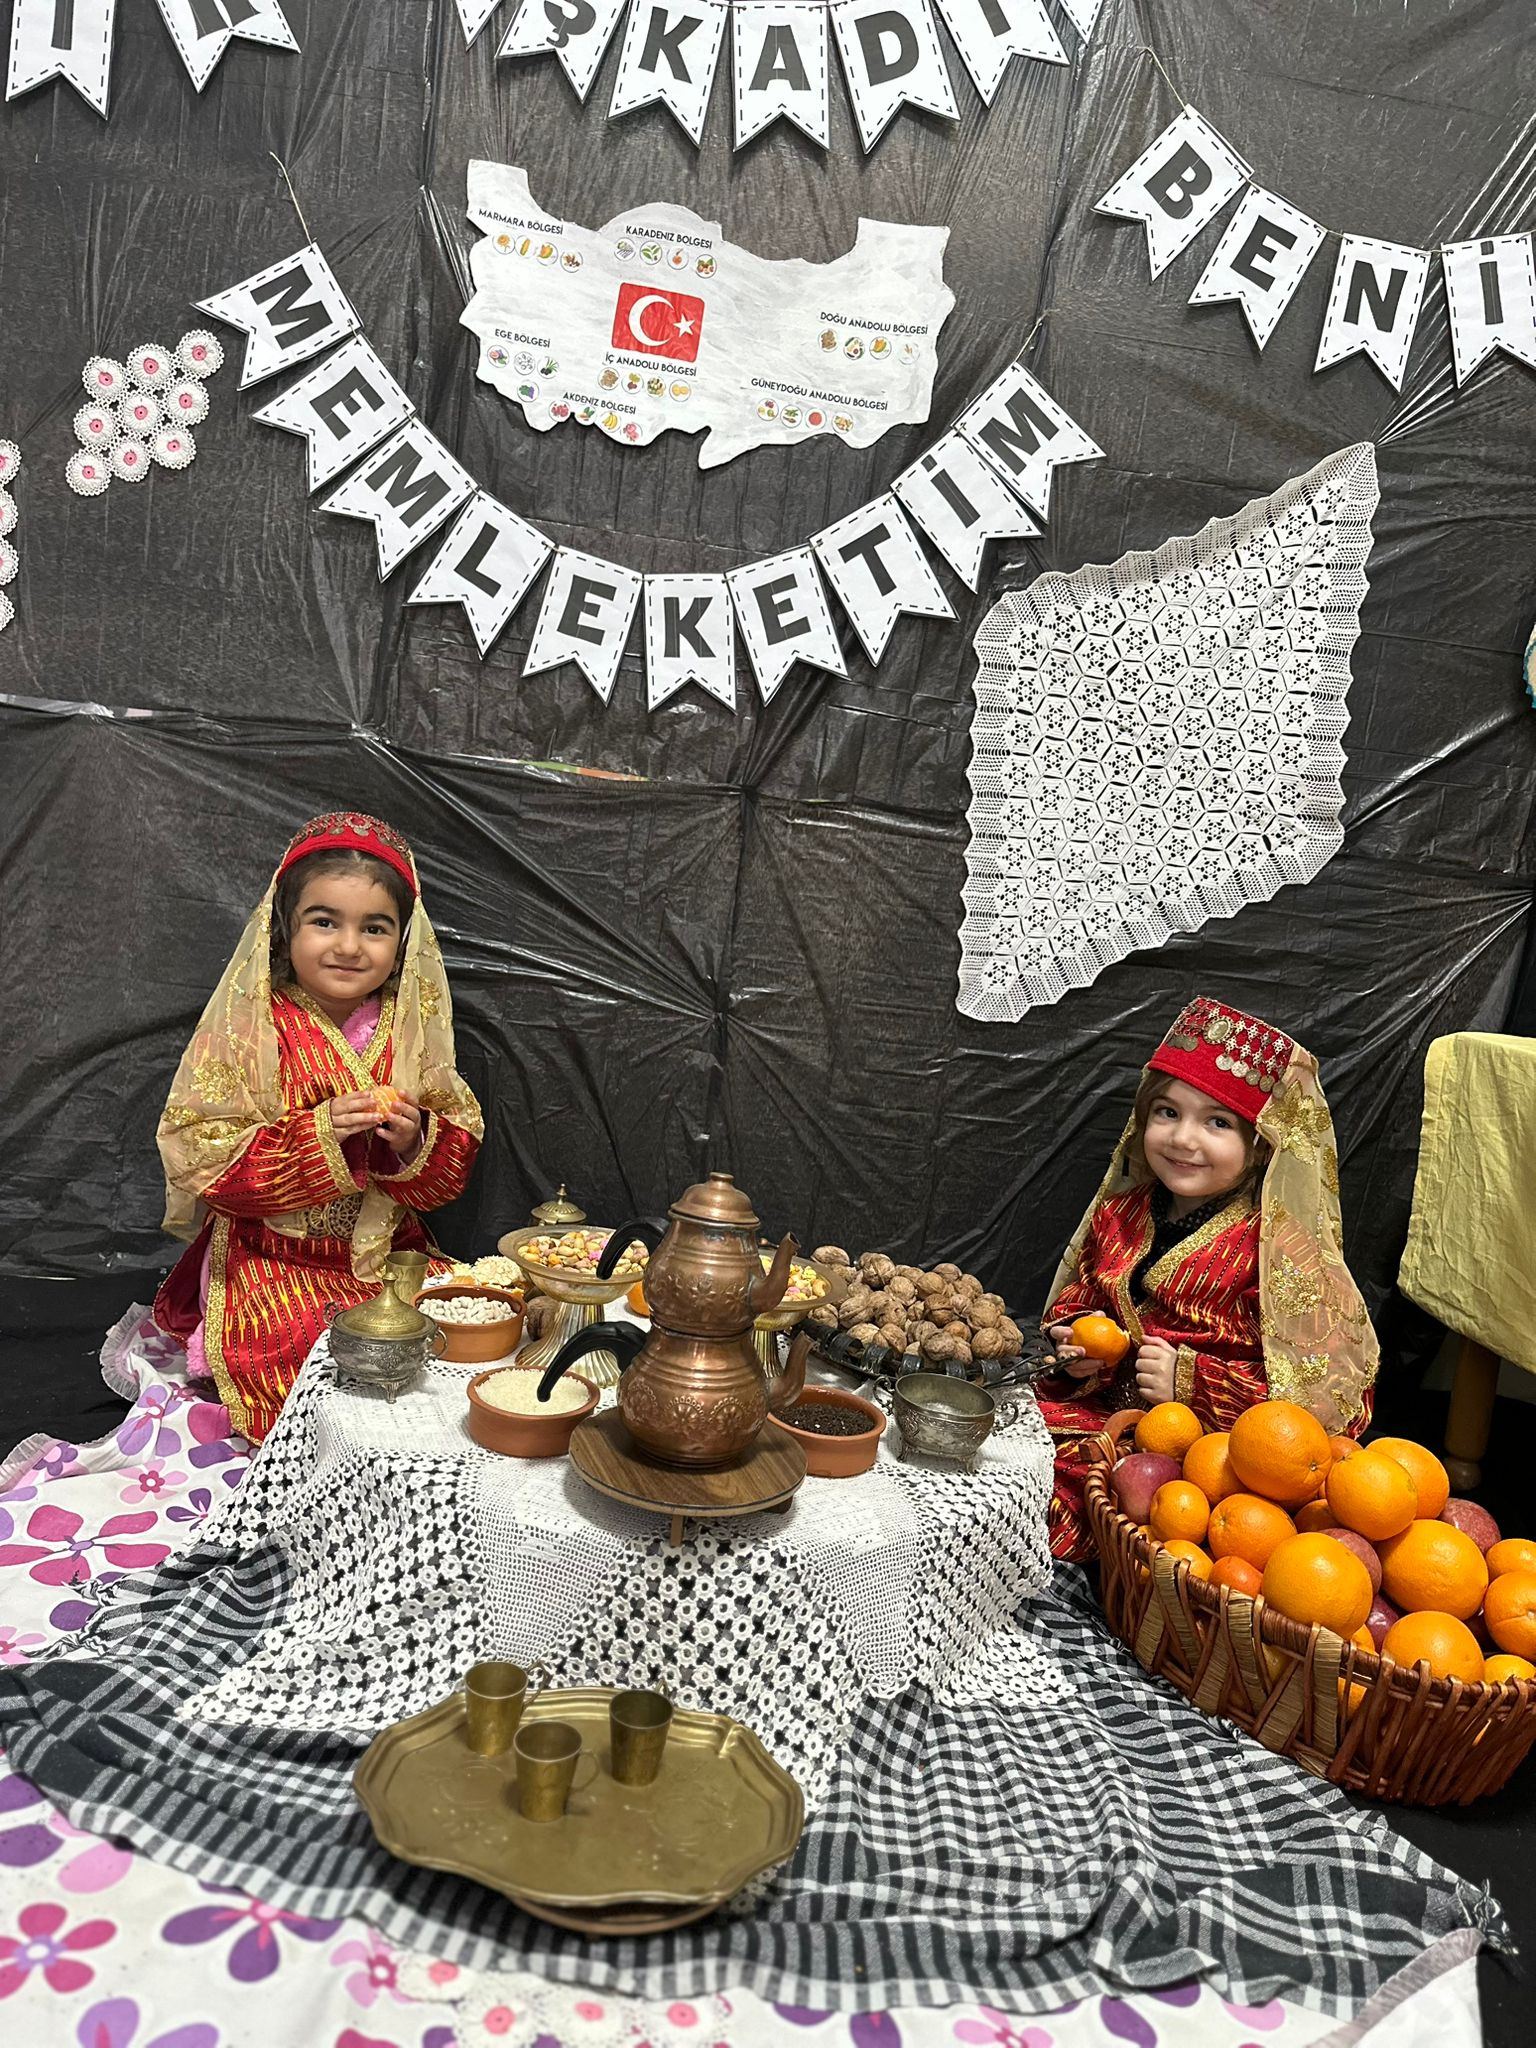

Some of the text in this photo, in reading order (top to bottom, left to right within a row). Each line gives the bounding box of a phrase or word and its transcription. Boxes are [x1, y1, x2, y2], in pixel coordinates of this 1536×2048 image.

[479, 208, 525, 228] MARMARA
[494, 328, 512, 340] EGE
[820, 311, 928, 335] DOĞU ANADOLU BÖLGESİ
[605, 351, 697, 377] İÇ ANADOLU BÖLGESİ
[808, 390, 852, 405] ANADOLU
[251, 262, 1059, 658] MEMLEKETİM
